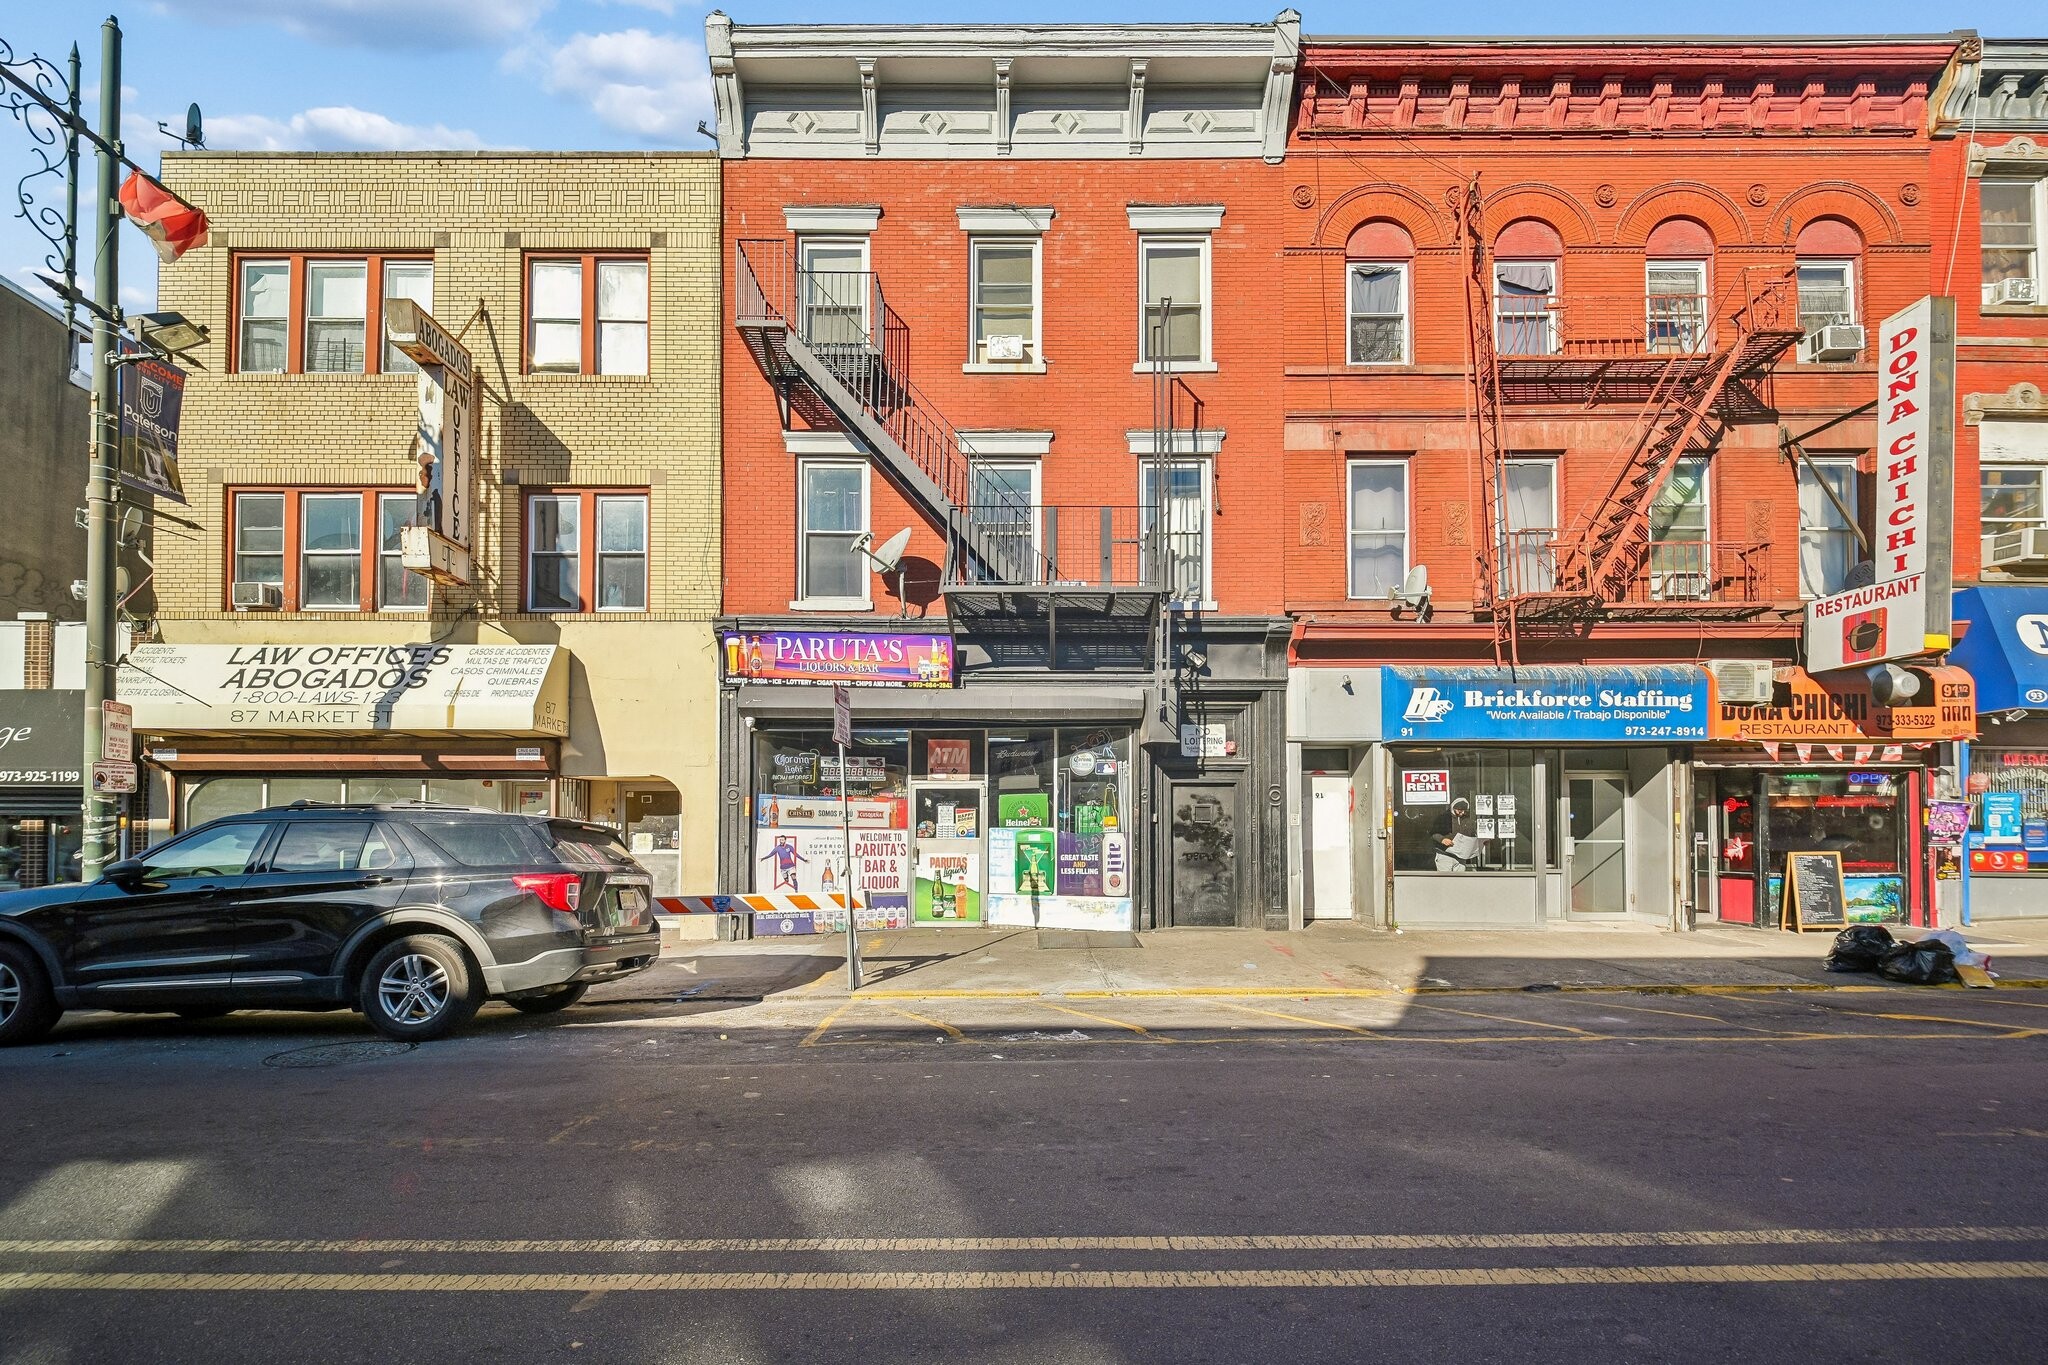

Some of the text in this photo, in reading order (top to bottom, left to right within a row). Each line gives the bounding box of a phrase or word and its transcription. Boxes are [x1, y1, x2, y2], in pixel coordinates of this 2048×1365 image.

[418, 317, 468, 378] ABOGADOS
[124, 346, 183, 385] WLCOME
[1886, 326, 1920, 425] DOÑA
[444, 371, 469, 410] LAW
[124, 402, 178, 442] Paterson
[451, 404, 461, 541] OFFICE
[1886, 431, 1918, 574] CHICHI
[1815, 575, 1922, 618] RESTAURANT
[138, 647, 176, 655] ACCIDENTS
[469, 647, 551, 656] CASOS DE ACCIDENTES
[775, 636, 903, 663] PARUTA'S
[131, 656, 187, 664] TRAFFIC TICKETS
[226, 646, 453, 666] LAW OFFICES
[465, 657, 548, 665] MULTAS DE TRAFICO
[450, 667, 543, 675] CASOS CRIMINALES
[799, 661, 880, 673] LIQUORS & BAR
[219, 668, 433, 689] ABOGADOS
[487, 677, 540, 686] QUIEBRAS
[124, 688, 149, 697] ESTATE
[231, 690, 402, 704] 1-800-LAWS-123
[471, 689, 482, 698] DE
[490, 689, 535, 698] PROPIEDADES
[2030, 692, 2043, 700] 93
[1464, 689, 1693, 712] Brickforce Staffing
[545, 701, 557, 715] 87
[1788, 693, 1868, 721] CHICHI
[230, 710, 395, 723] 87 MARKET ST
[1518, 710, 1564, 720] Available
[1573, 710, 1611, 721] Trabajo
[1876, 714, 1935, 726] 973-333-5322
[110, 722, 128, 731] PARKING
[534, 714, 567, 734] MARKET
[1740, 723, 1849, 735] RESTAURANT
[1195, 728, 1210, 736] NO
[1400, 726, 1705, 737] 91 973-247-8914
[1185, 737, 1223, 745] LOITERING
[774, 753, 810, 766] Corona
[930, 747, 968, 764] ATM
[996, 749, 1040, 759] Budweiser
[0, 770, 80, 782] 973-925-1199
[1411, 774, 1440, 782] FOR
[1407, 783, 1445, 791] RENT
[817, 809, 837, 818] SOMOS
[1005, 816, 1042, 827] Heine
[859, 832, 902, 842] WELCOME TO
[855, 843, 907, 857] PARUTA'S
[1107, 842, 1125, 873] Lite
[864, 859, 898, 873] BAR &
[862, 875, 900, 890] LIQUOR
